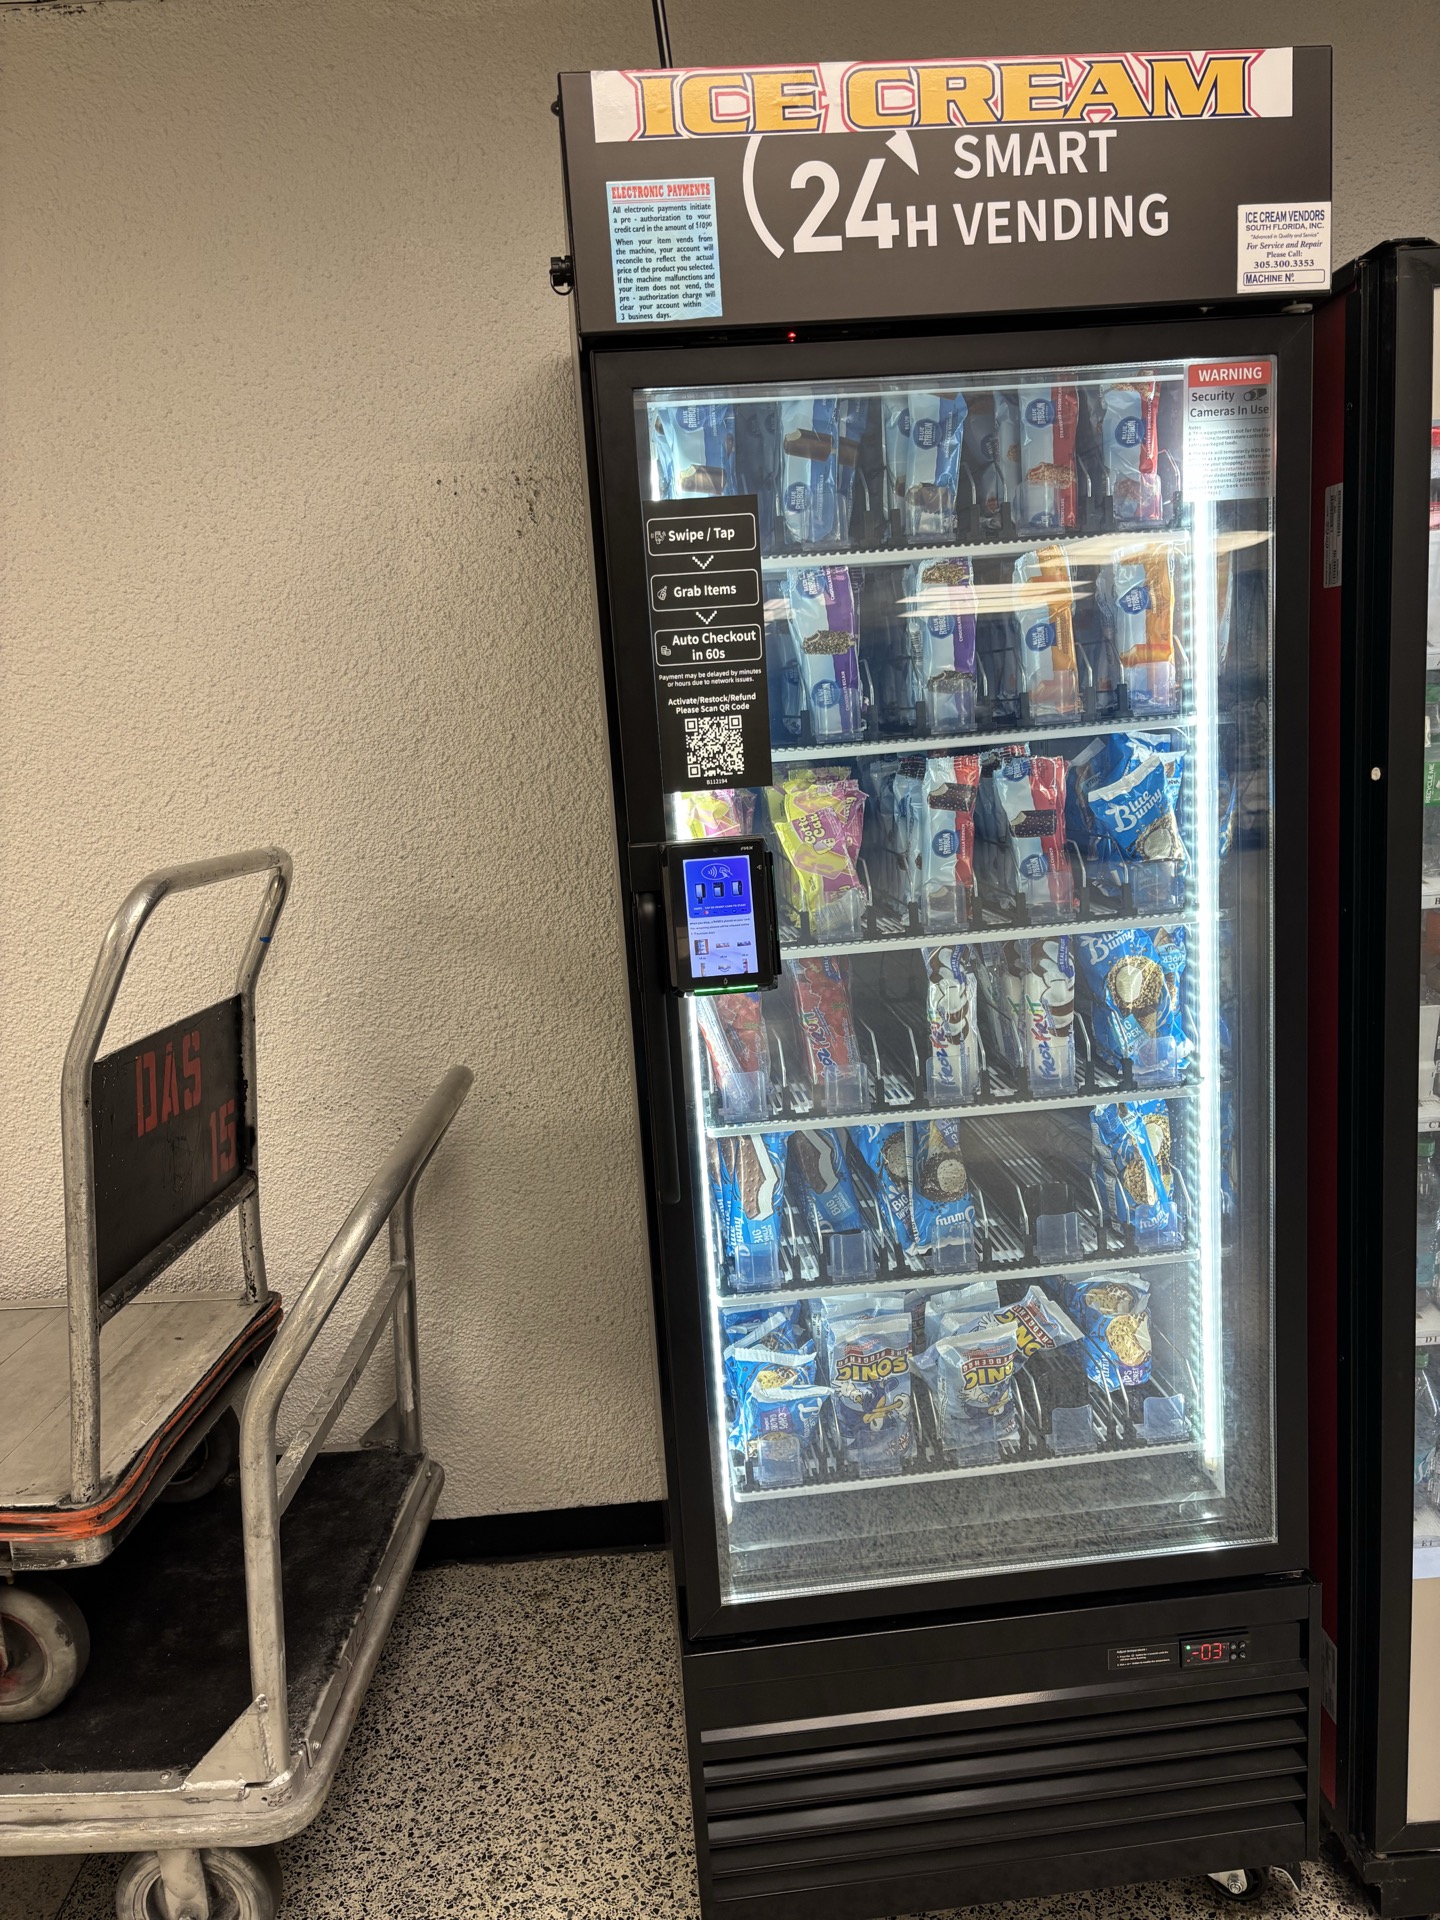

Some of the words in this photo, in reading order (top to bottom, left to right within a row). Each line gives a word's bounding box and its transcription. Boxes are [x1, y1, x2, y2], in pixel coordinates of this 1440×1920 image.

[638, 69, 825, 138] ICE
[843, 57, 1250, 129] CREAM
[954, 129, 1117, 179] SMART
[611, 185, 664, 199] ELECTRONIC
[667, 183, 710, 196] PAYMENTS
[624, 205, 654, 213] electronic
[658, 204, 686, 213] payments
[640, 214, 681, 222] authorization
[953, 194, 1169, 246] VENDING
[1245, 212, 1258, 223] ICE
[1260, 211, 1286, 222] CREAM
[1289, 210, 1324, 221] VENDORS
[1300, 240, 1322, 249] Repair
[652, 265, 675, 274] product
[1254, 260, 1314, 269] 305.300.3353
[1246, 274, 1282, 284] MACHINE
[682, 292, 702, 300] charge
[1199, 367, 1262, 382] WARNING
[1192, 391, 1235, 402] Security
[1190, 406, 1235, 418] Cameras
[1238, 406, 1247, 415] In
[1251, 405, 1269, 414] Use
[668, 529, 704, 543] Swipe
[714, 527, 735, 540] Tap
[674, 584, 701, 598] Grab
[704, 583, 736, 596] Items
[672, 633, 699, 646] Auto
[702, 630, 756, 644] Checkout
[692, 649, 703, 660] in
[706, 648, 725, 660] 60s
[707, 670, 729, 678] delayed
[668, 693, 756, 705] Activate/Restock/Refund
[676, 705, 699, 714] Please
[701, 704, 717, 712] Scan
[719, 704, 729, 712] QR
[136, 1030, 201, 1138] DAS
[210, 1099, 237, 1182] 15
[838, 1356, 907, 1380] SONIC
[965, 1361, 1013, 1390] ONIC
